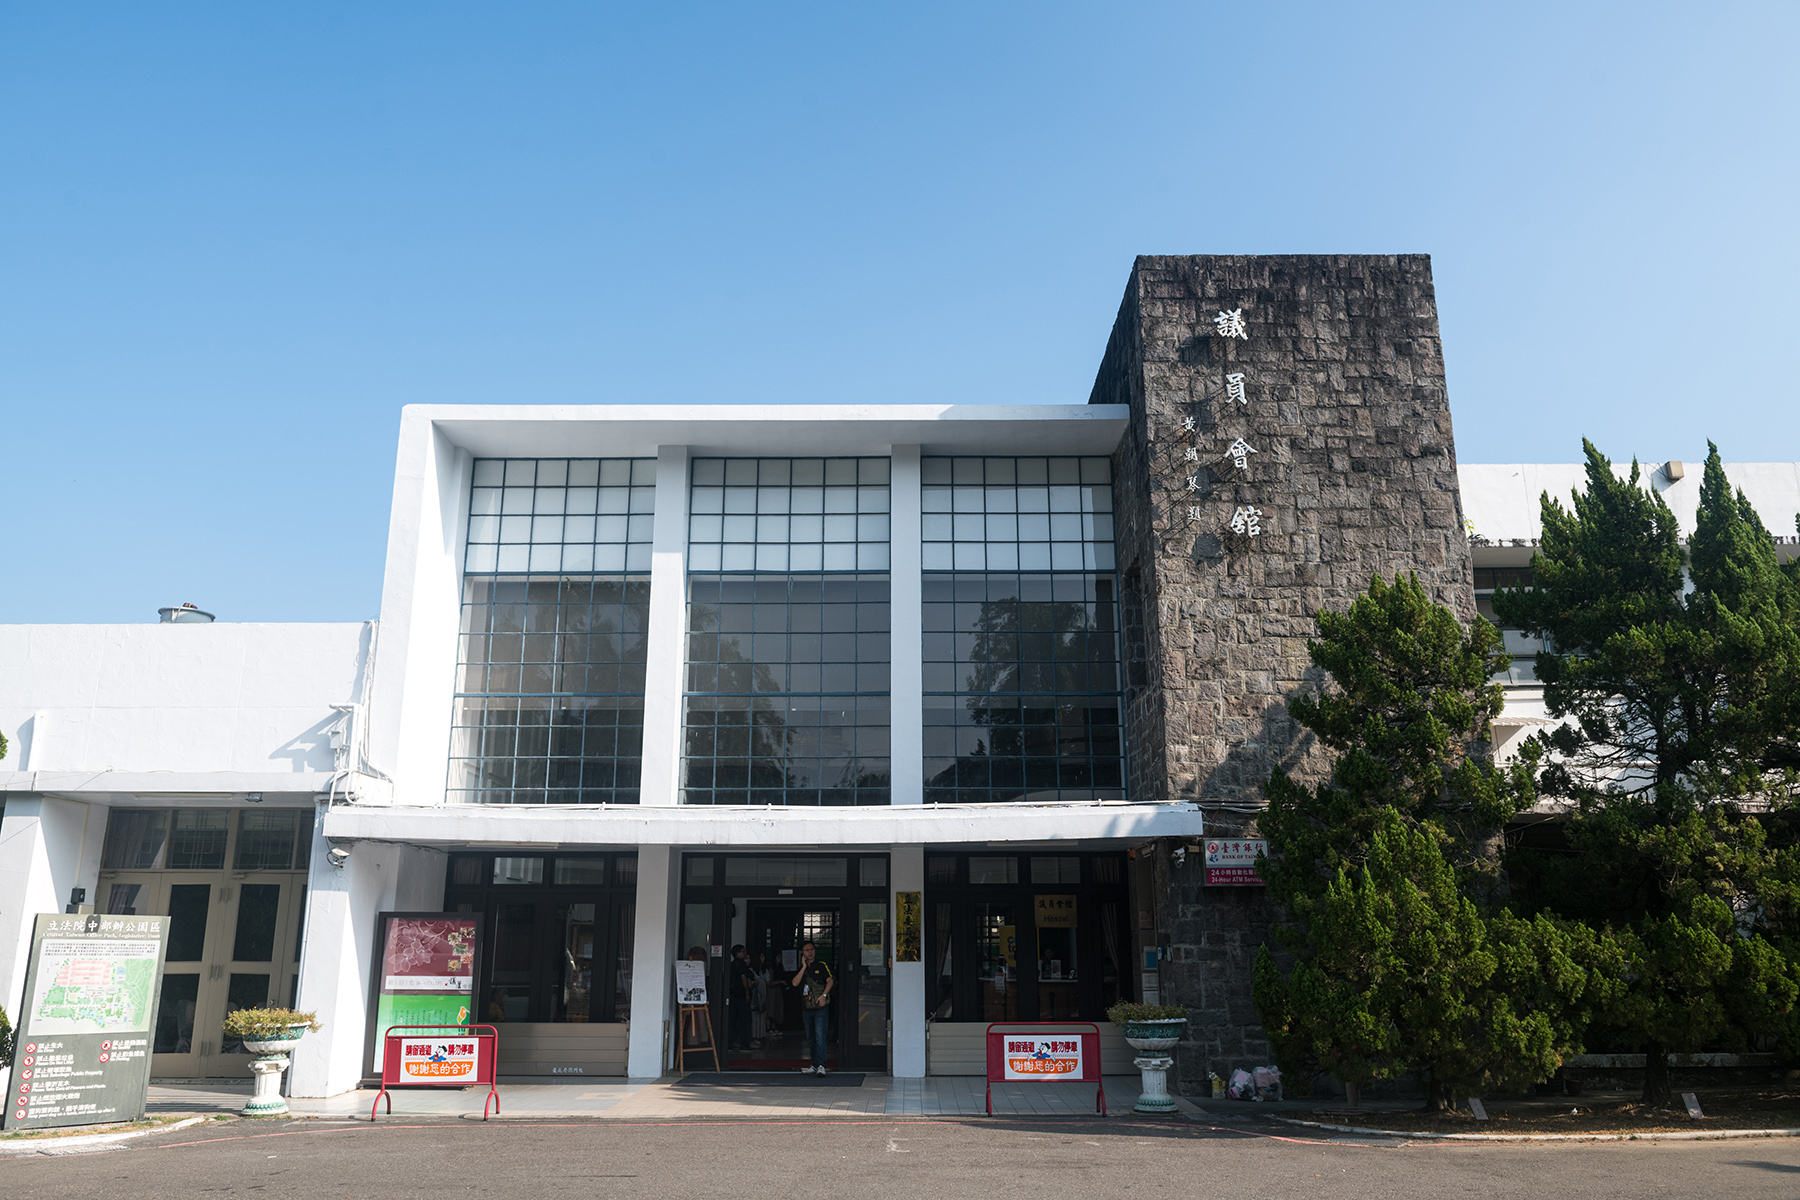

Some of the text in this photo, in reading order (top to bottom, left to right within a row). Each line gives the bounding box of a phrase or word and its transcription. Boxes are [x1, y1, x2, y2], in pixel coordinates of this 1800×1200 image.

[1213, 308, 1262, 538] 議員會館
[1181, 416, 1201, 521] 黃朝琴題
[1043, 914, 1069, 923] Hostel
[405, 1044, 474, 1056] 請留通道 請勿停車
[1008, 1041, 1077, 1053] 請留通道 請勿停車
[408, 1063, 471, 1075] 謝謝您的合作
[1013, 1060, 1076, 1072] 謝謝您的合作
